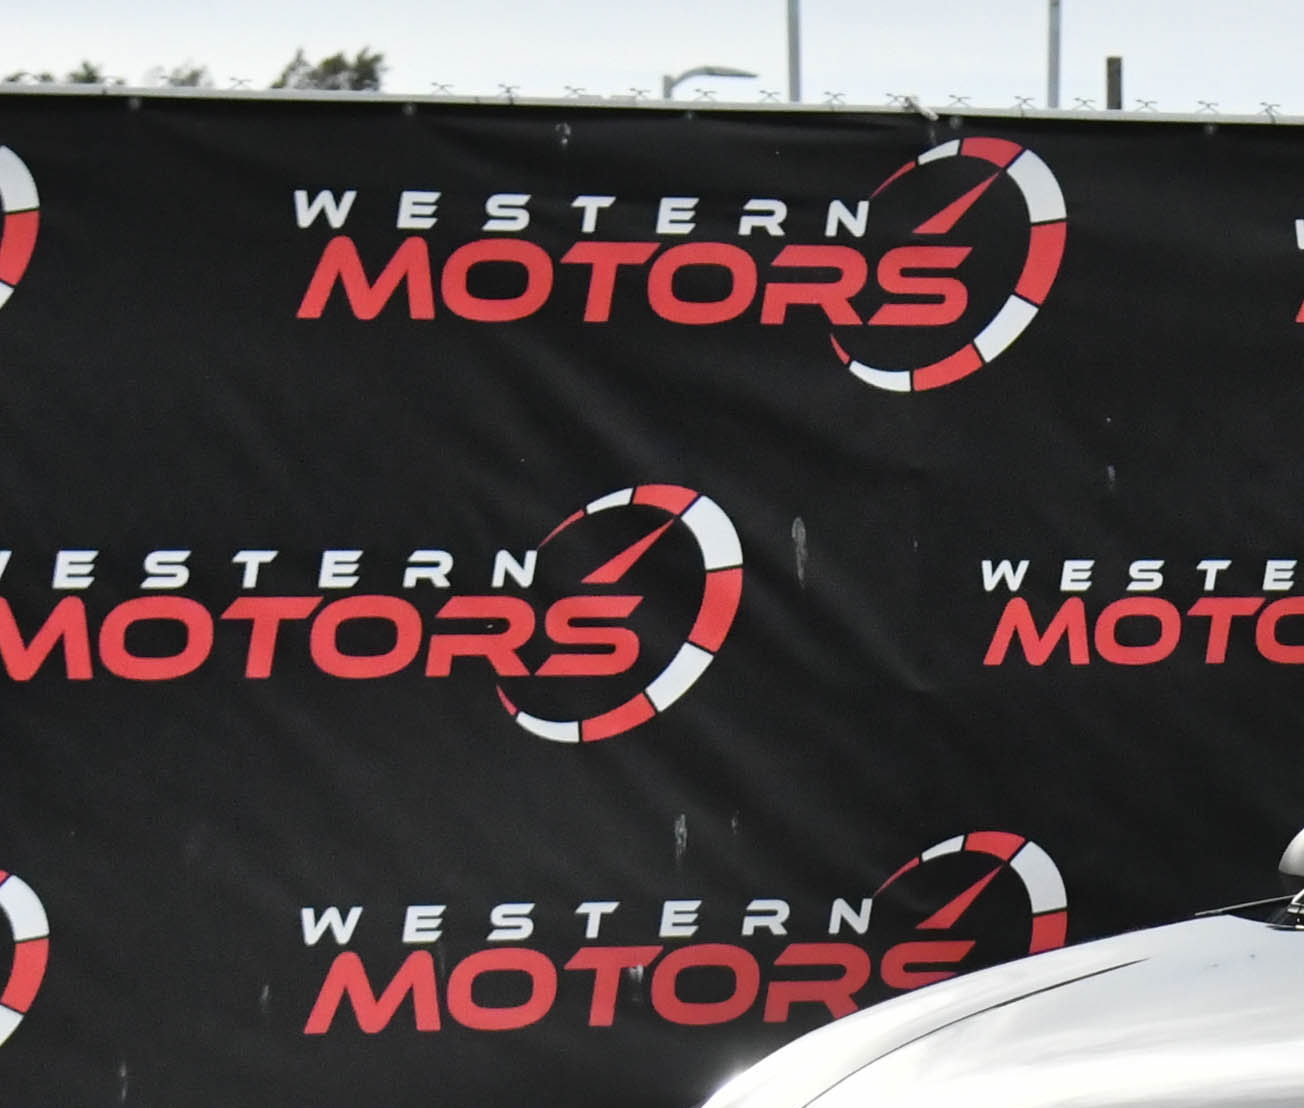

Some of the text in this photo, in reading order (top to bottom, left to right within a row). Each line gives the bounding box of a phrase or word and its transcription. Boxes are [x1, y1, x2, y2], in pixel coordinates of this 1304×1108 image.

[295, 191, 869, 237] WESTERN
[297, 236, 971, 325] MOTORS
[0, 550, 537, 588] ESTERN
[0, 595, 642, 681] MOTORS
[302, 899, 872, 945] WESTERN
